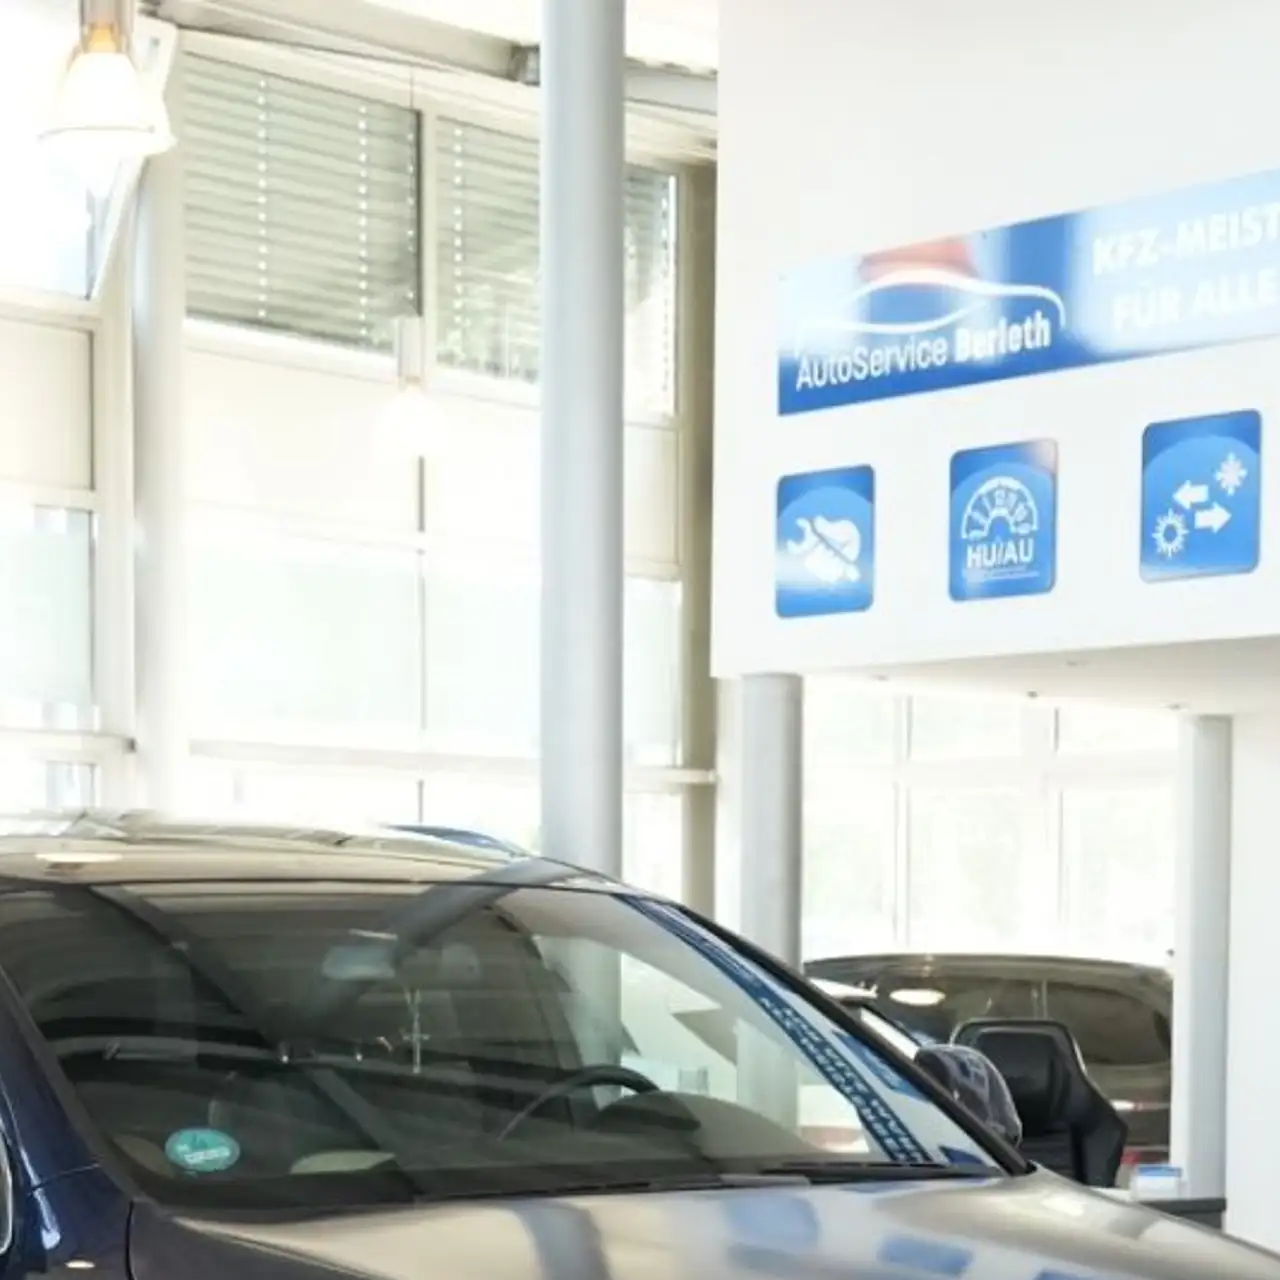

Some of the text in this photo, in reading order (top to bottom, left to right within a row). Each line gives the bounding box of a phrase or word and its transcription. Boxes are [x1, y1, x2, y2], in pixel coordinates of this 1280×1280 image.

[1114, 281, 1185, 332] FÜR
[1194, 264, 1280, 317] ALLE
[795, 309, 1051, 391] AutoService Berleth
[965, 538, 1034, 568] HU/AU
